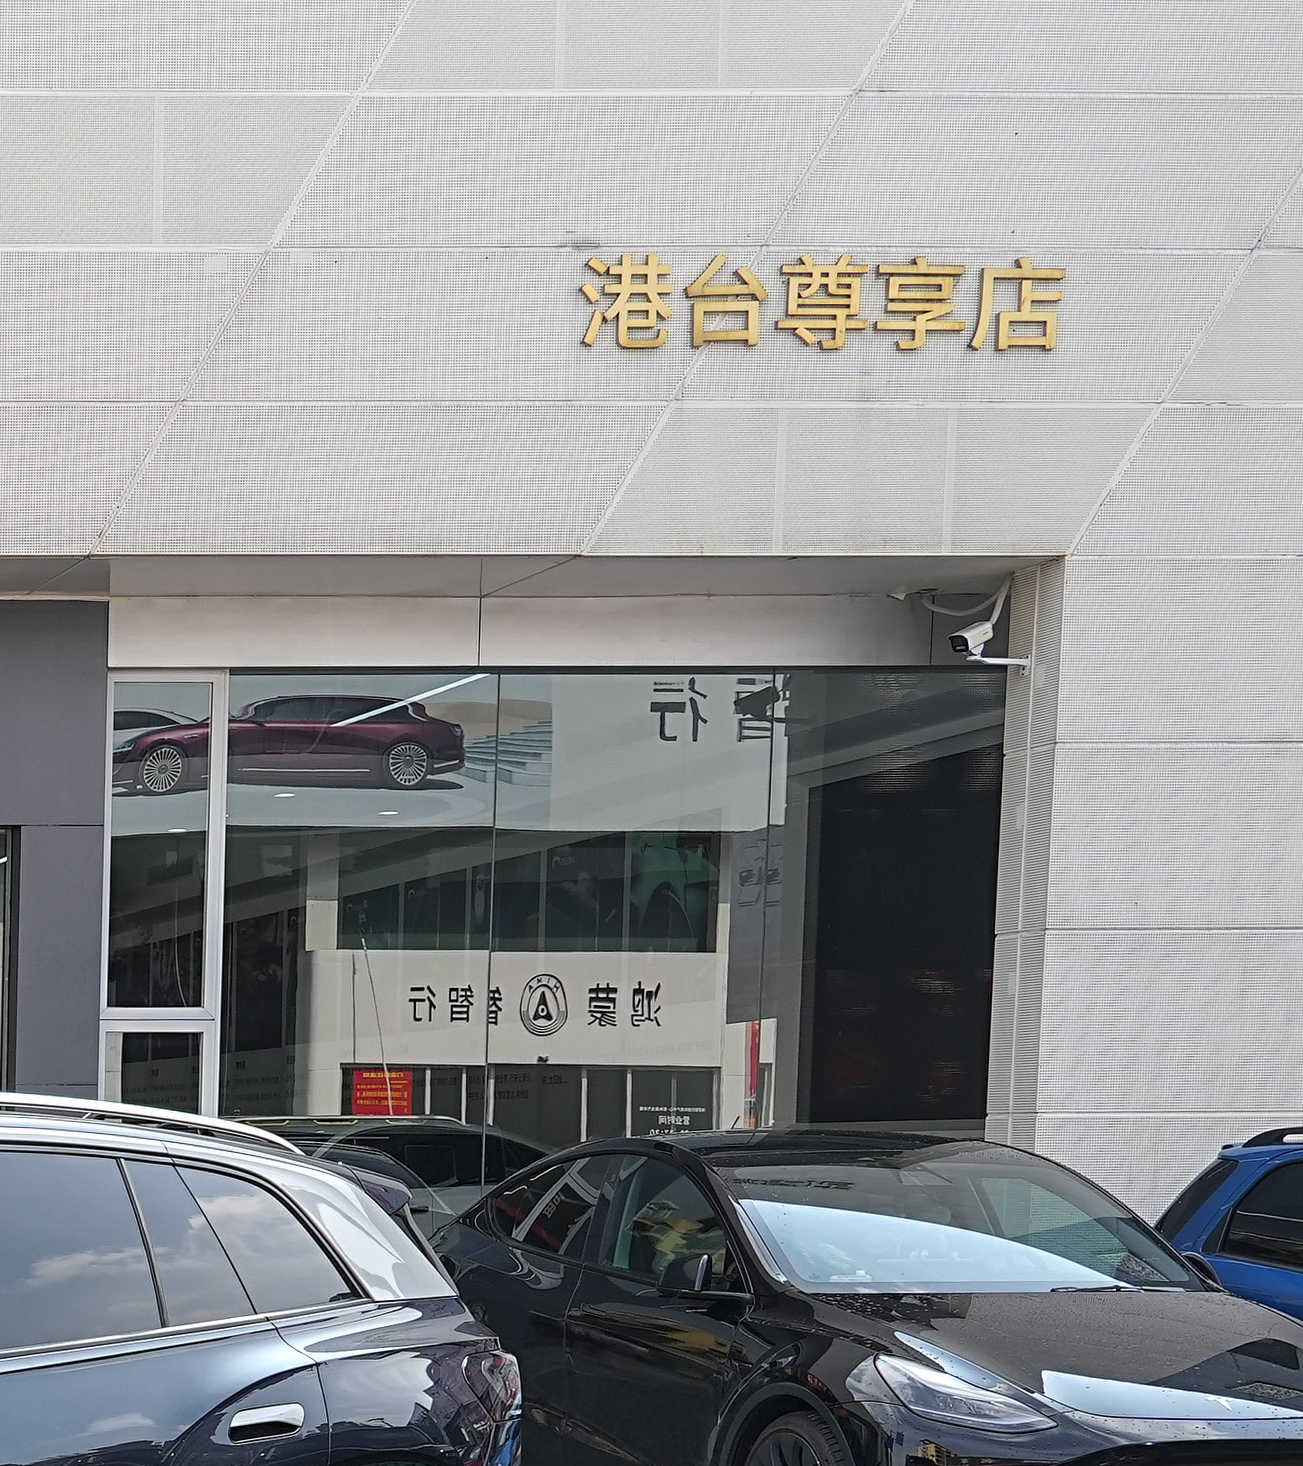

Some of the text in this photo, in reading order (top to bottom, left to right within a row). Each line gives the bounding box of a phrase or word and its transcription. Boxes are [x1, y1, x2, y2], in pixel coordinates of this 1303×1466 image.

[580, 252, 1067, 351] 港台尊享店
